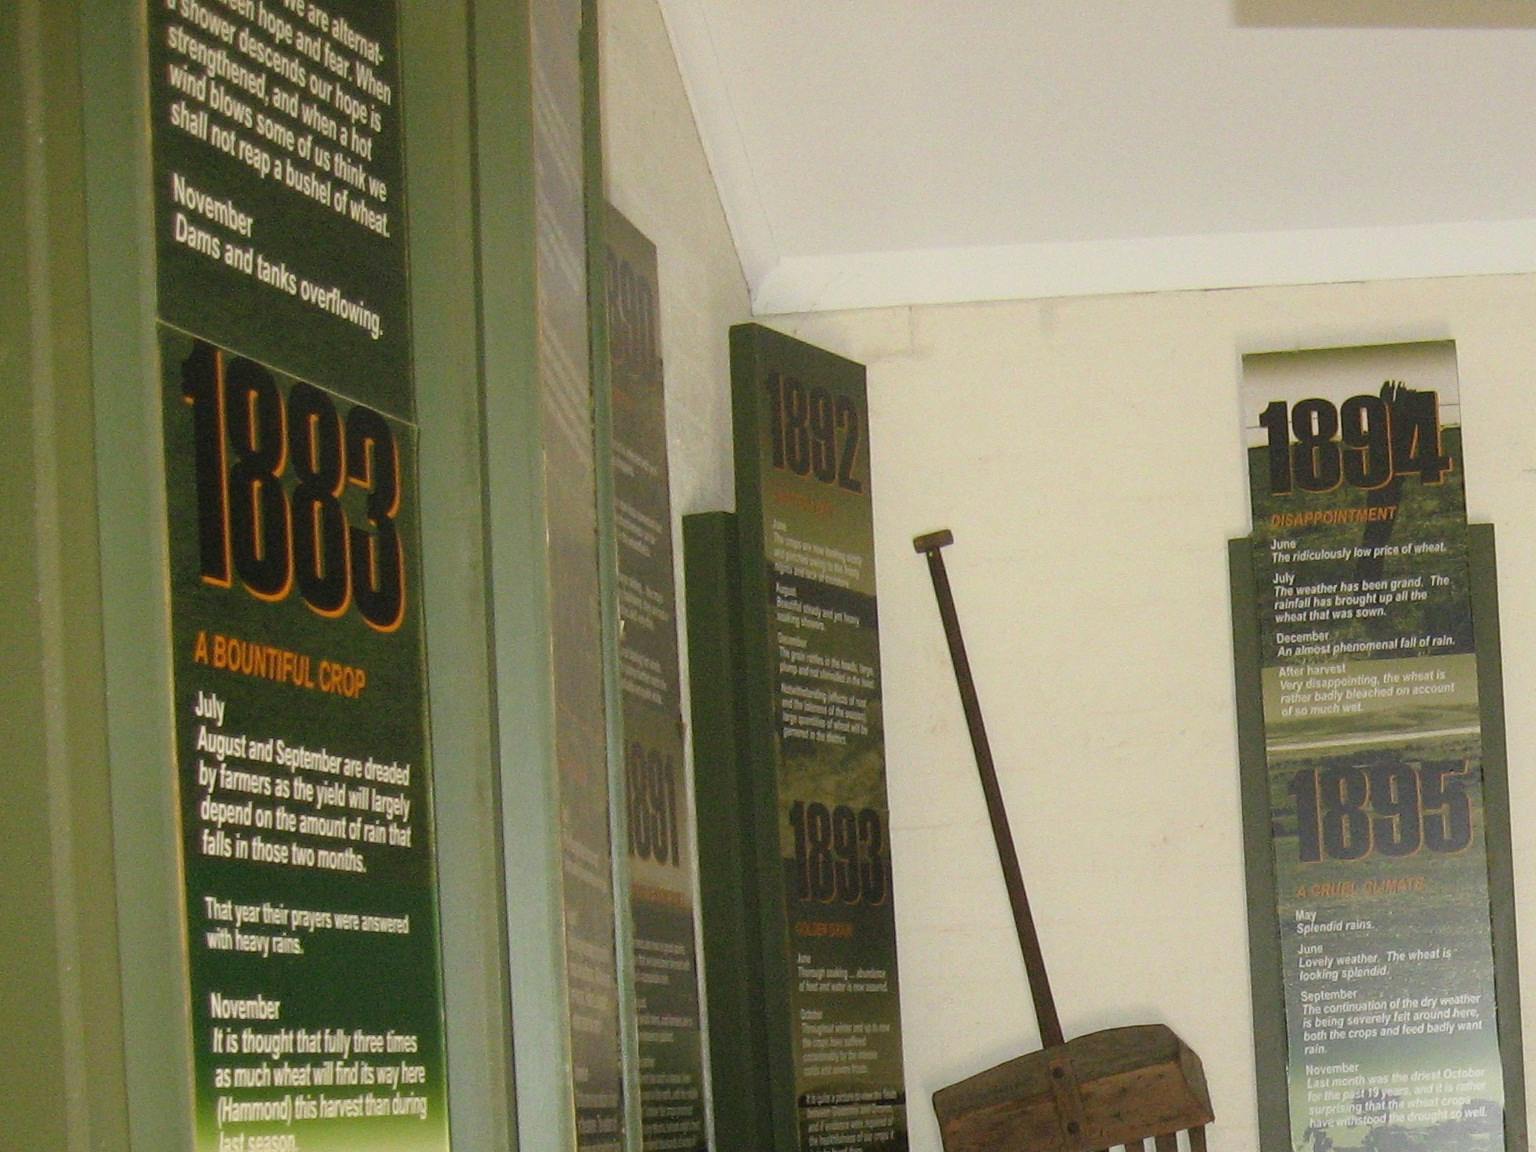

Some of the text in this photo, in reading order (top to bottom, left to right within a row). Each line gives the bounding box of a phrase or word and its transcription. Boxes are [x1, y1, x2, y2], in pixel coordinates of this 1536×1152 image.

[307, 4, 328, 33] are
[180, 0, 236, 45] shower
[239, 28, 306, 88] descends
[310, 75, 333, 102] our
[336, 84, 368, 123] hope
[371, 104, 382, 133] is
[258, 2, 293, 45] hope
[295, 32, 321, 62] and
[324, 42, 352, 81] fear.
[356, 62, 391, 105] When
[168, 25, 372, 162] strengthened, and when a hot
[169, 64, 387, 202] wind blows some of us think we
[171, 101, 390, 238] shall not reap a bushel of wheat.
[174, 172, 253, 238] November
[175, 213, 384, 340] Dams and tanks overflowing.
[768, 373, 865, 495] 1892
[1259, 389, 1454, 497] 1894
[181, 340, 407, 633] 1883
[1270, 506, 1397, 527] DISAPPOINTMENT
[1270, 539, 1296, 550] June
[1272, 552, 1290, 563] The
[1293, 548, 1351, 561] ridiculously
[1354, 547, 1371, 558] low
[1374, 546, 1399, 558] price
[1401, 543, 1413, 554] of
[1273, 573, 1295, 585] July
[1277, 631, 1329, 644] December
[1277, 635, 1455, 657] An almost phenomenal fall of rain.
[194, 631, 367, 698] A BOUNTIFUL CROP
[195, 691, 225, 727] July
[197, 725, 410, 786] August and September are dreaded
[199, 760, 410, 822] by farmers as the yield will largely
[1289, 757, 1474, 864] 1895
[201, 795, 412, 848] depend on the amount of rain that
[202, 829, 367, 873] falls in those two months.
[788, 800, 888, 906] 1893
[205, 896, 409, 934] That year their prayers were answered
[1296, 910, 1317, 924] May
[1297, 921, 1343, 936] Splendid
[206, 928, 233, 950] with
[235, 929, 269, 958] heavy
[210, 993, 280, 1020] November
[213, 1028, 418, 1060] It is thought that fully three times
[215, 1061, 425, 1090] as much wheat will find its way here
[217, 1092, 428, 1129] (Hammond) this harvest than during
